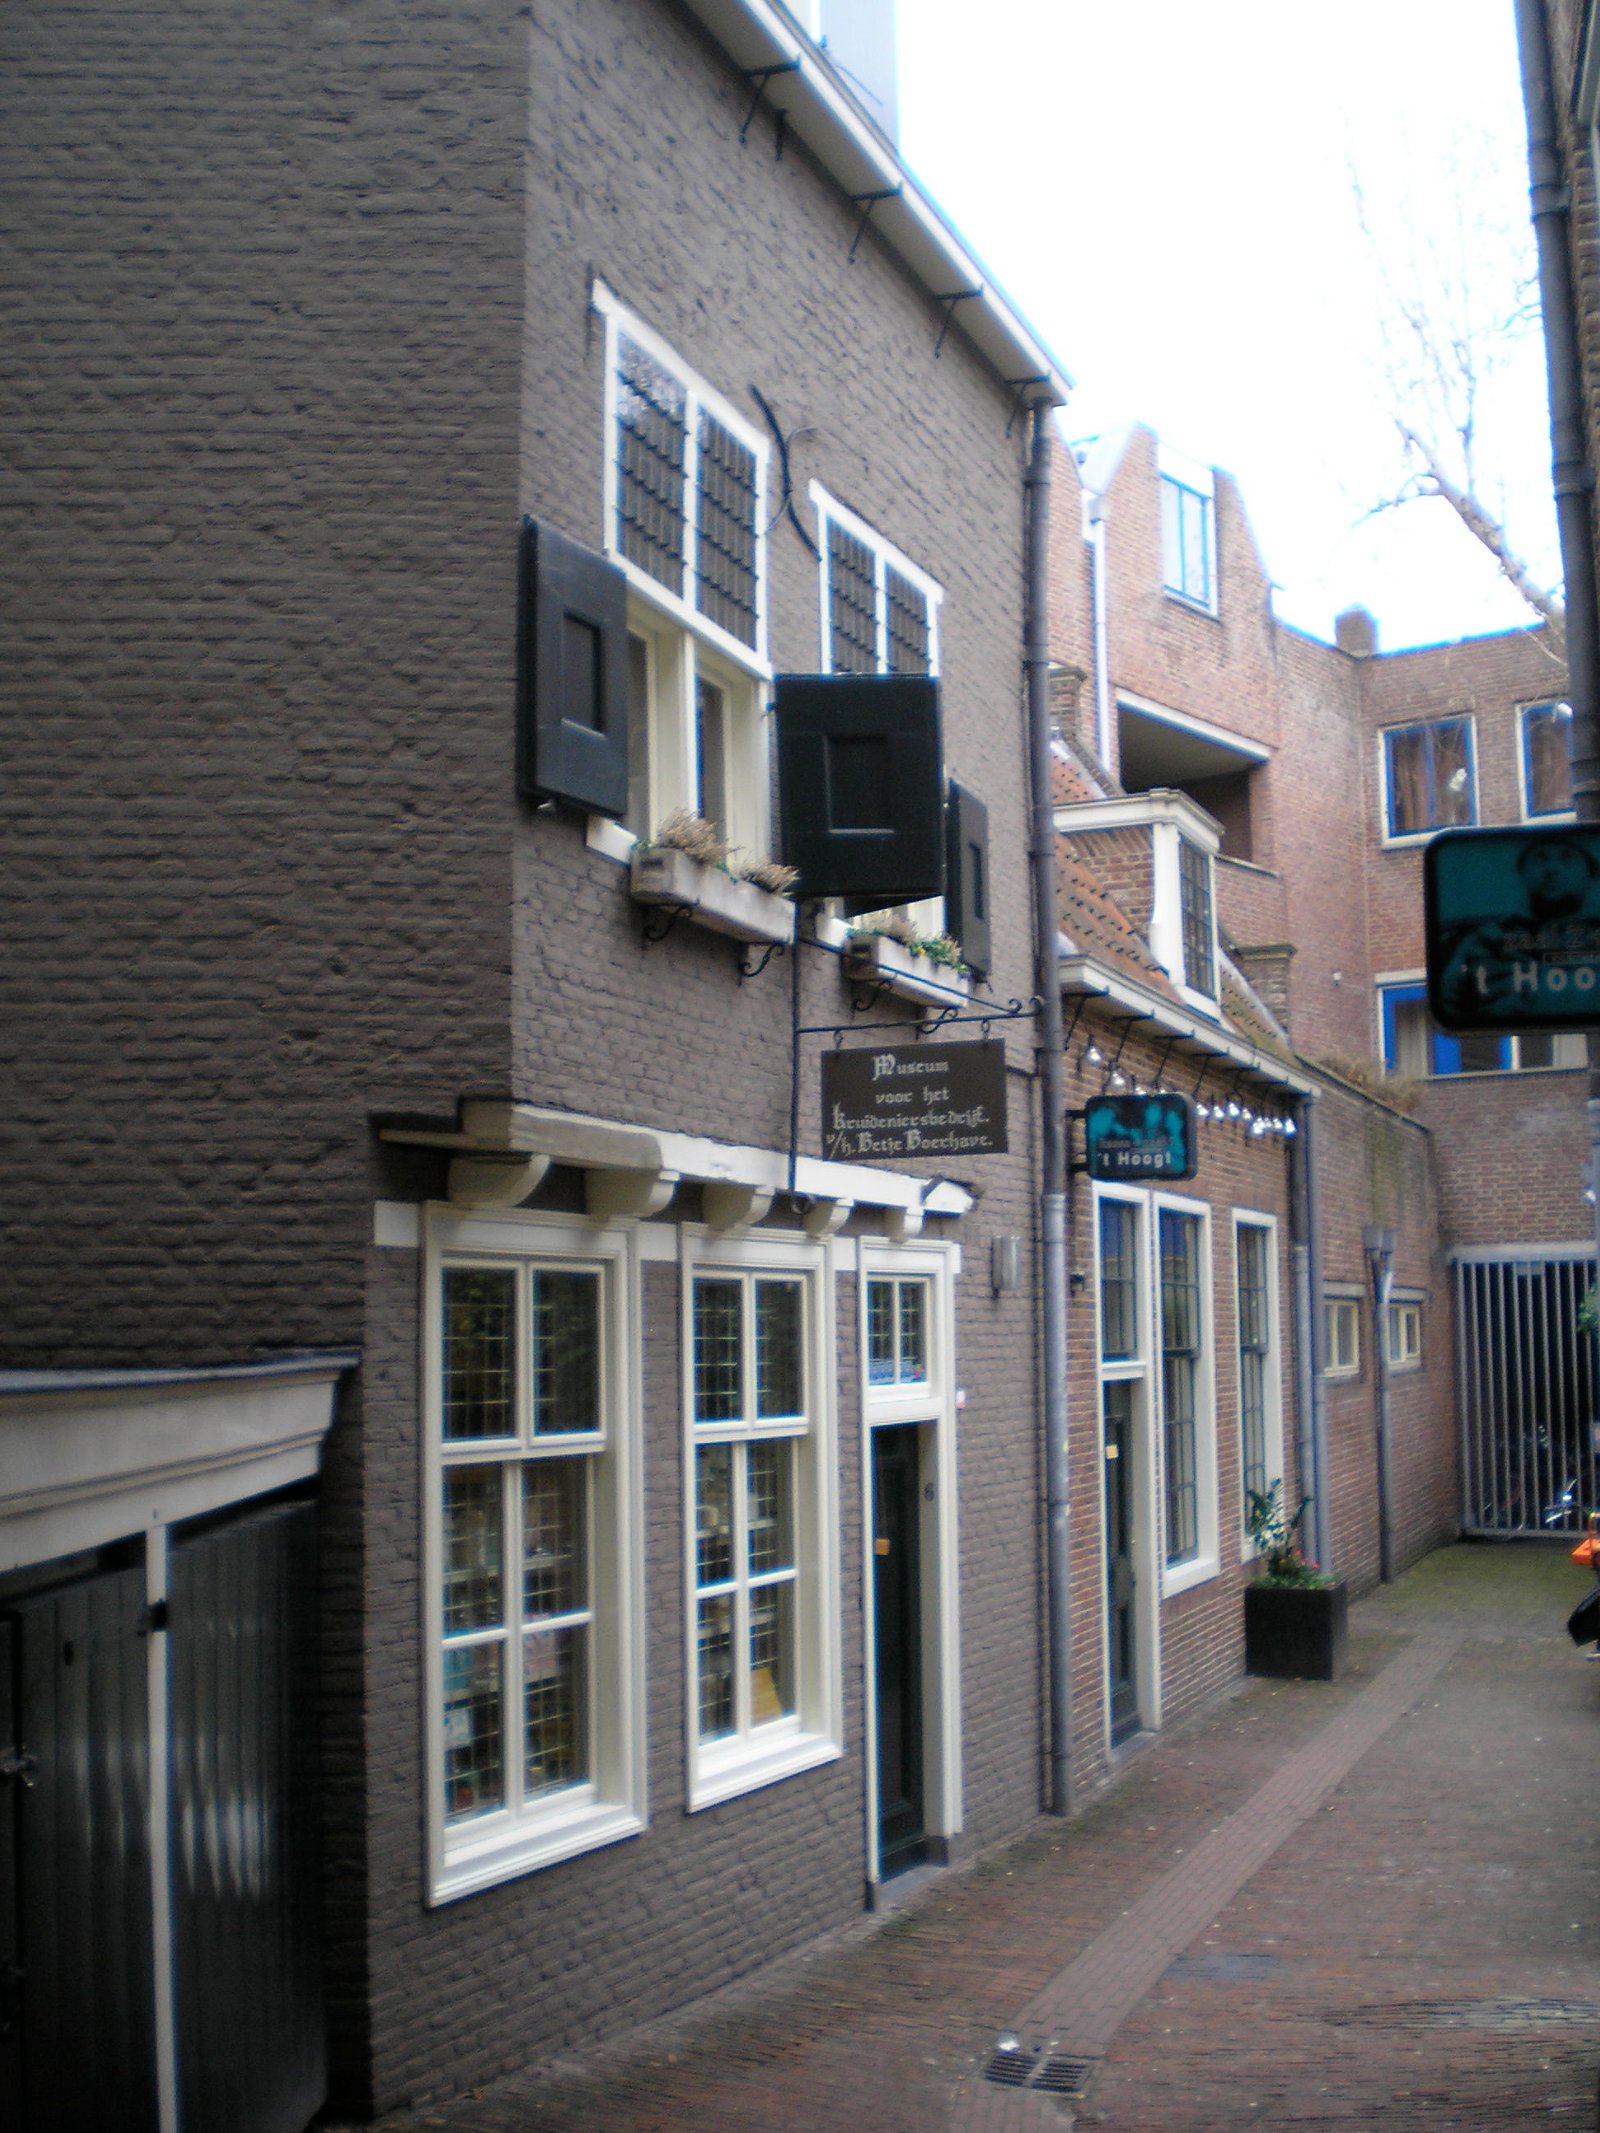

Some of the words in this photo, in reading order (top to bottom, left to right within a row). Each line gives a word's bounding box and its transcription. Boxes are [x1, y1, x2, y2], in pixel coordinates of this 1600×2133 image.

[872, 1053, 949, 1081] Museum
[875, 1092, 913, 1104] voor
[923, 1086, 949, 1106] het
[1117, 1151, 1172, 1168] Hoogt
